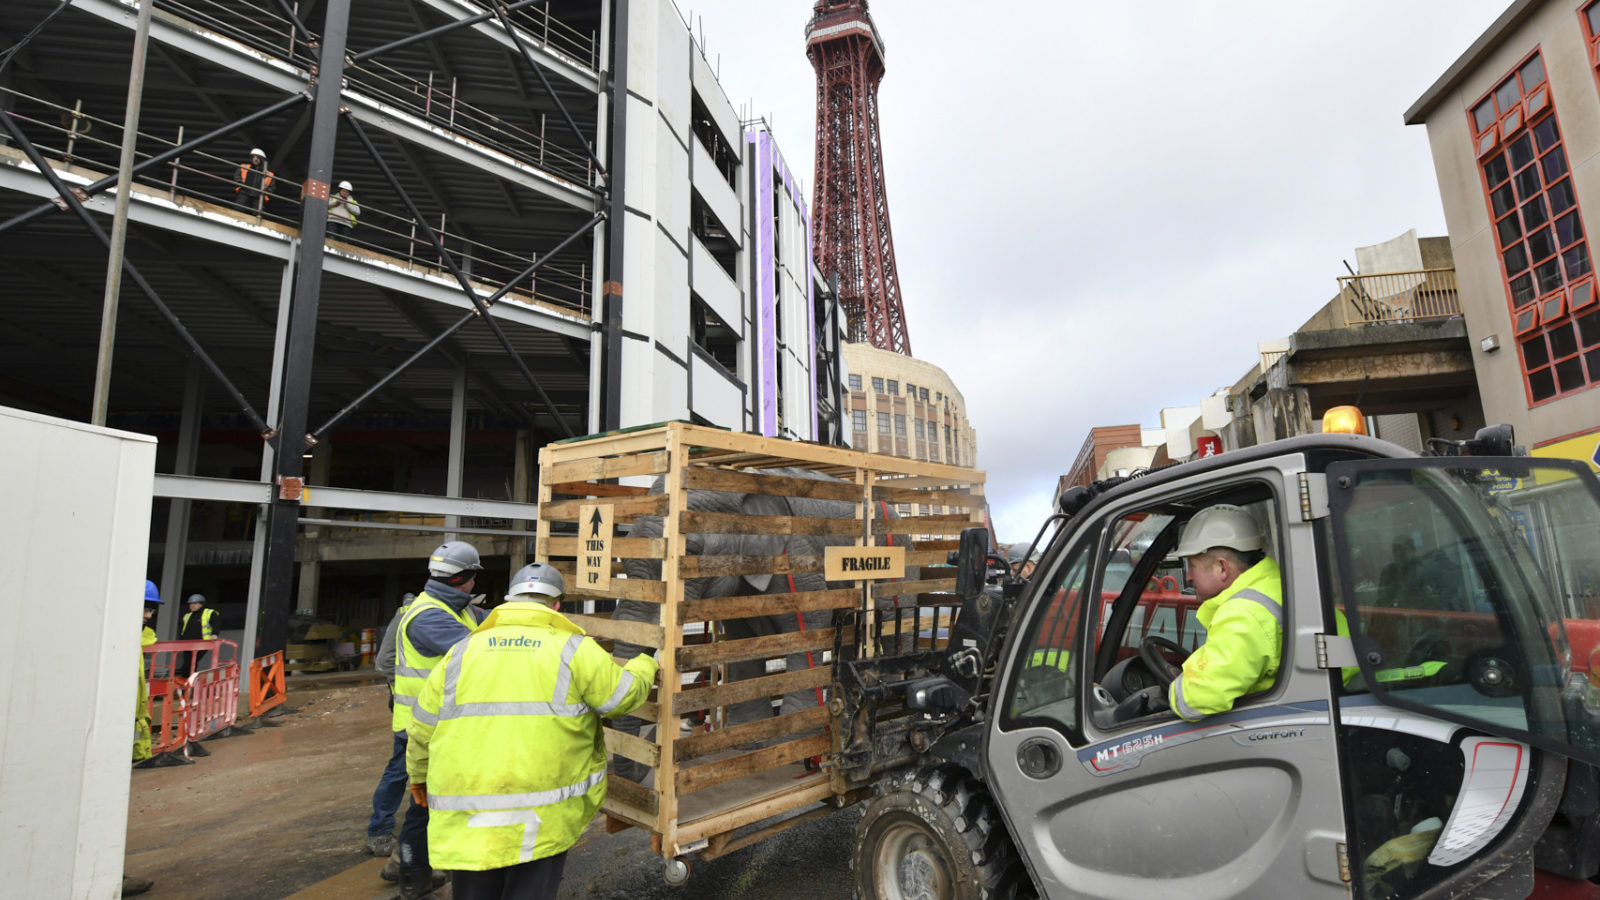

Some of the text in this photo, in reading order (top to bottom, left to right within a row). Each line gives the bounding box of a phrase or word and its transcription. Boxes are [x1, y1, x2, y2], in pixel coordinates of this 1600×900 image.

[586, 540, 604, 551] THIS
[587, 556, 602, 567] WAY
[842, 557, 891, 571] FRAGILE
[588, 572, 599, 584] UP
[488, 636, 542, 648] Warden
[1248, 728, 1305, 741] COMFORT
